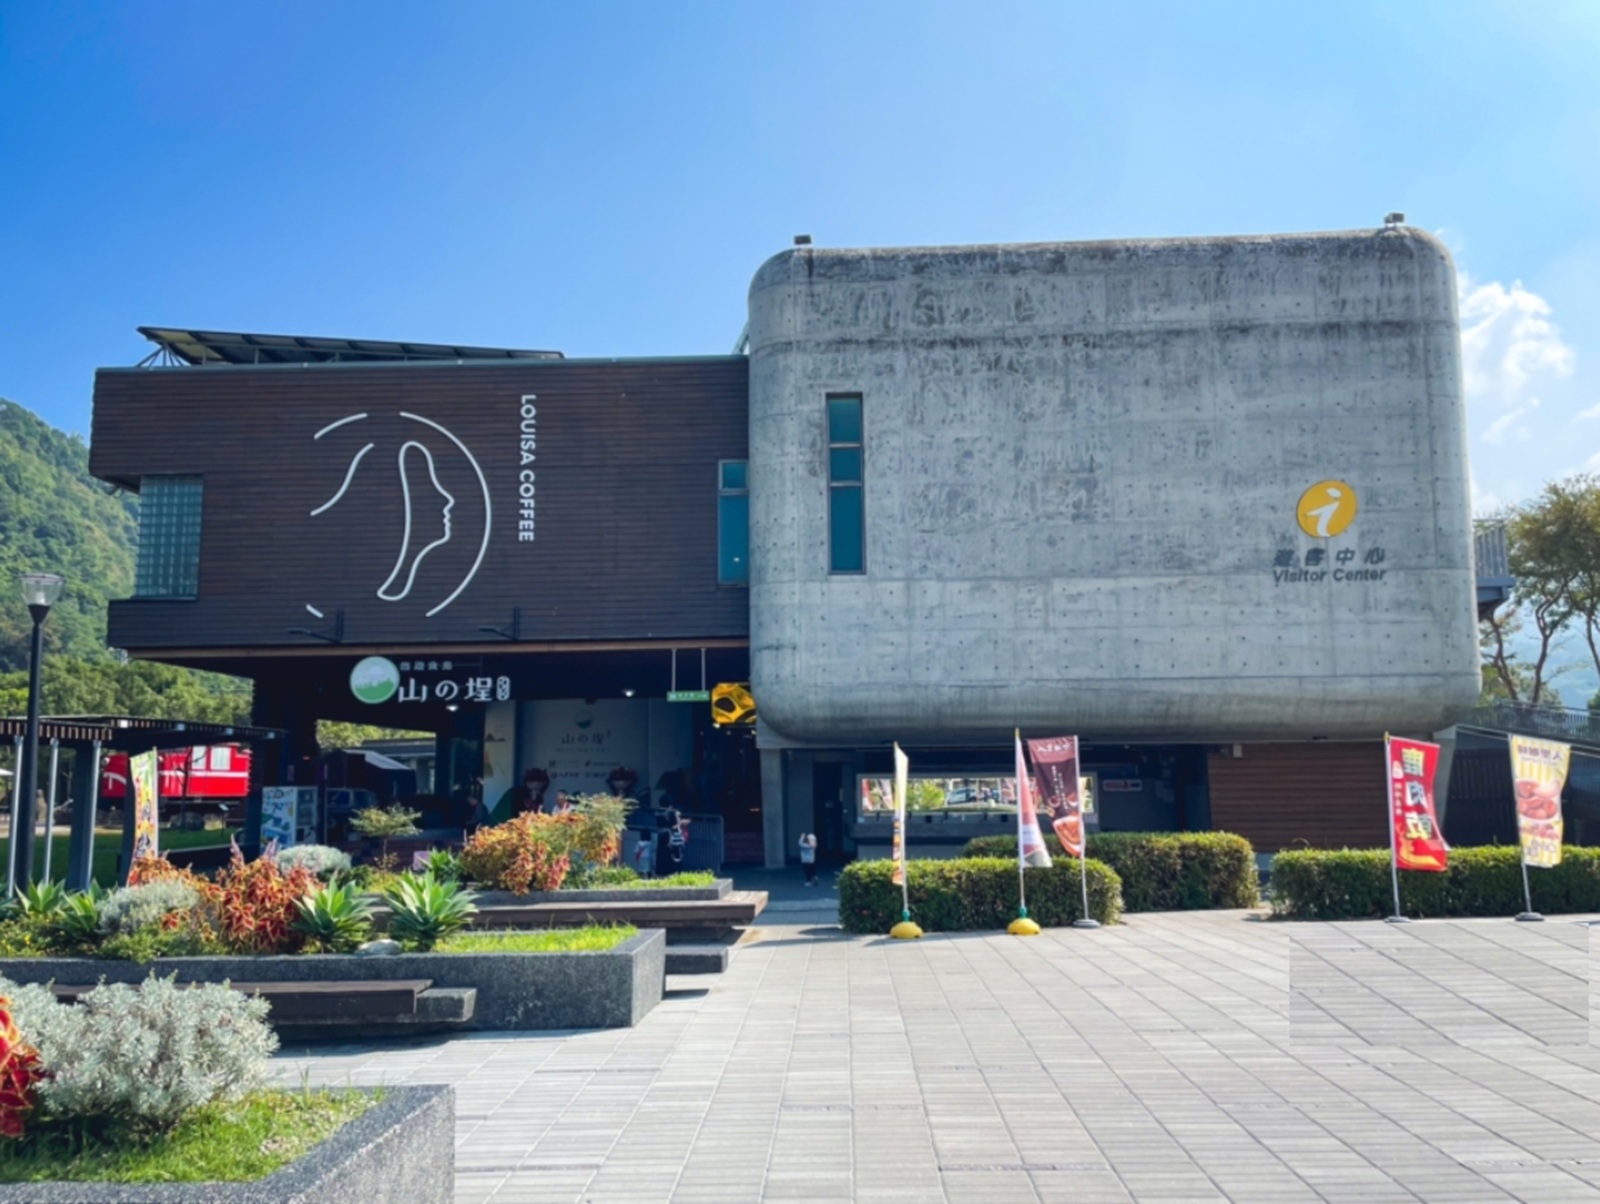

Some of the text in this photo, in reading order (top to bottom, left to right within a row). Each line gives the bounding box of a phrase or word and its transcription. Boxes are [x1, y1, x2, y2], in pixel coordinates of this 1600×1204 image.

[518, 394, 537, 542] LOUISA COFFEE
[1272, 567, 1387, 583] Visitor Center
